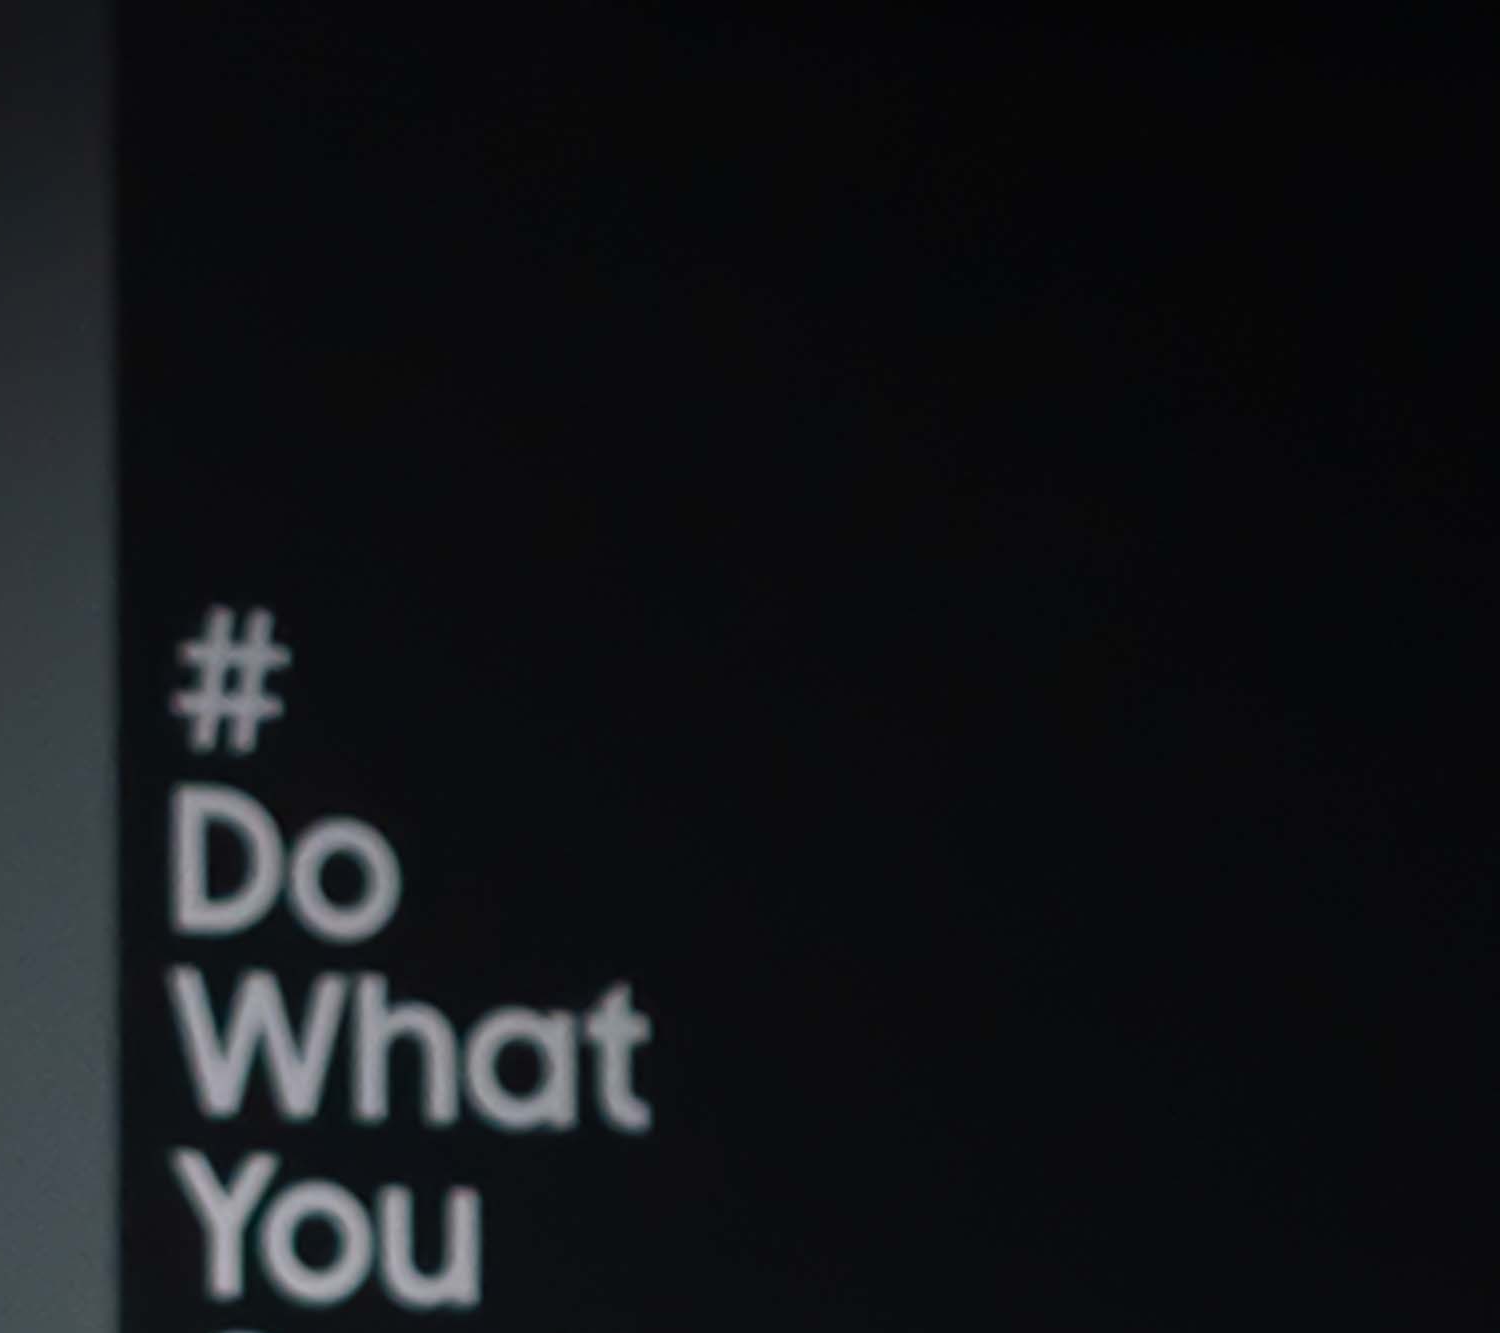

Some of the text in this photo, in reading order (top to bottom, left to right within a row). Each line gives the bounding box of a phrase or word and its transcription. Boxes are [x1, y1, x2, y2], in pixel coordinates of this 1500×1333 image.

[172, 605, 291, 753] #
[169, 783, 403, 943] Do
[166, 966, 653, 1134] What
[170, 1148, 483, 1309] You
